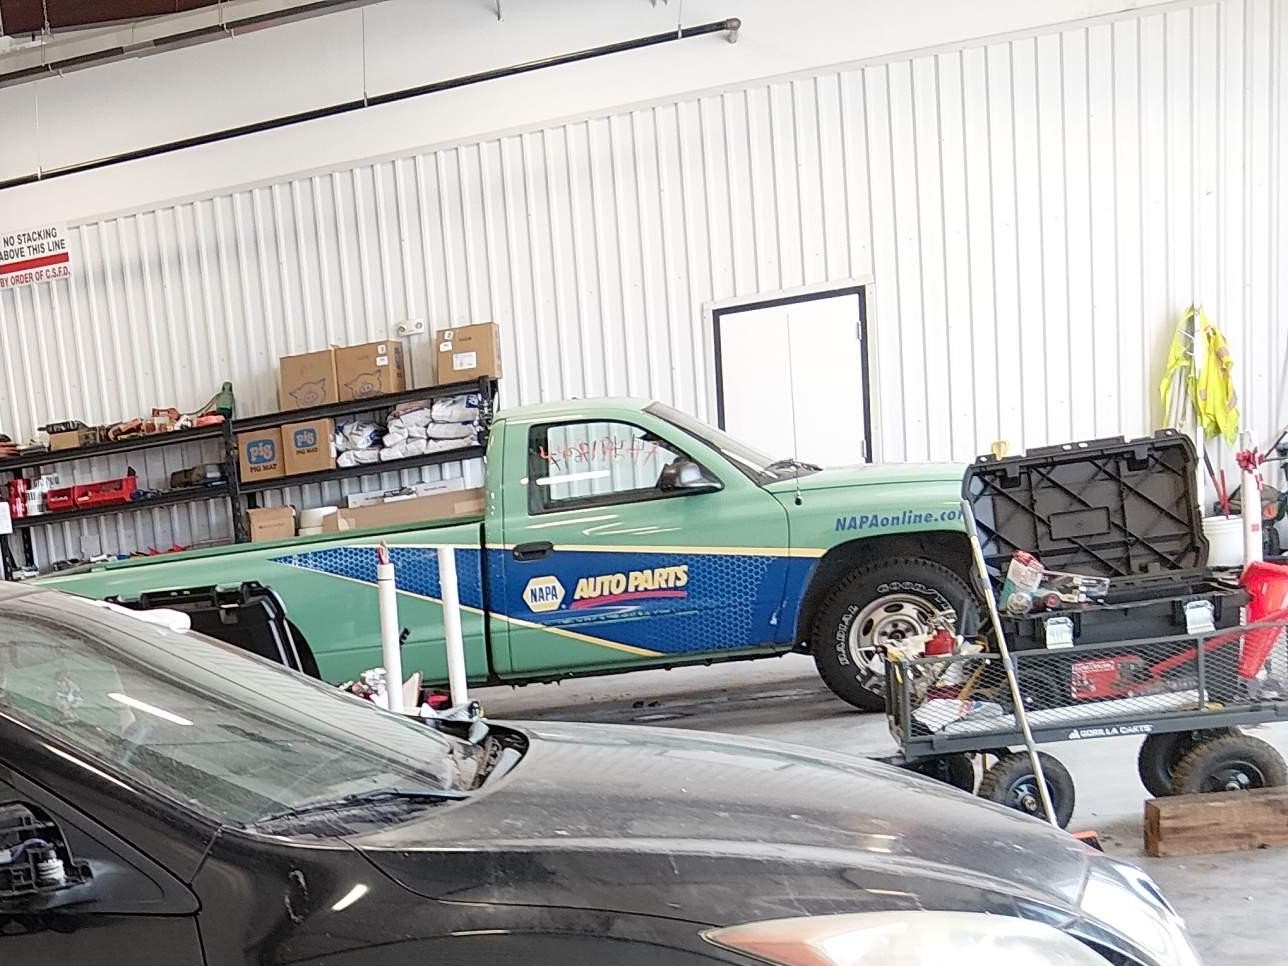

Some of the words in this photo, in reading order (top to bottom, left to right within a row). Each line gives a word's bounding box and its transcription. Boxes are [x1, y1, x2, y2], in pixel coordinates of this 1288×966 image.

[3, 235, 15, 248] NO
[17, 227, 57, 245] STACKING
[27, 243, 45, 256] THIS
[47, 239, 66, 252] LINE
[0, 278, 9, 288] BY
[10, 272, 34, 286] ORDER
[35, 270, 44, 281] OF
[250, 442, 272, 462] pig
[530, 585, 558, 603] NAPA
[574, 573, 626, 599] AUTO
[628, 565, 689, 592] PARTS
